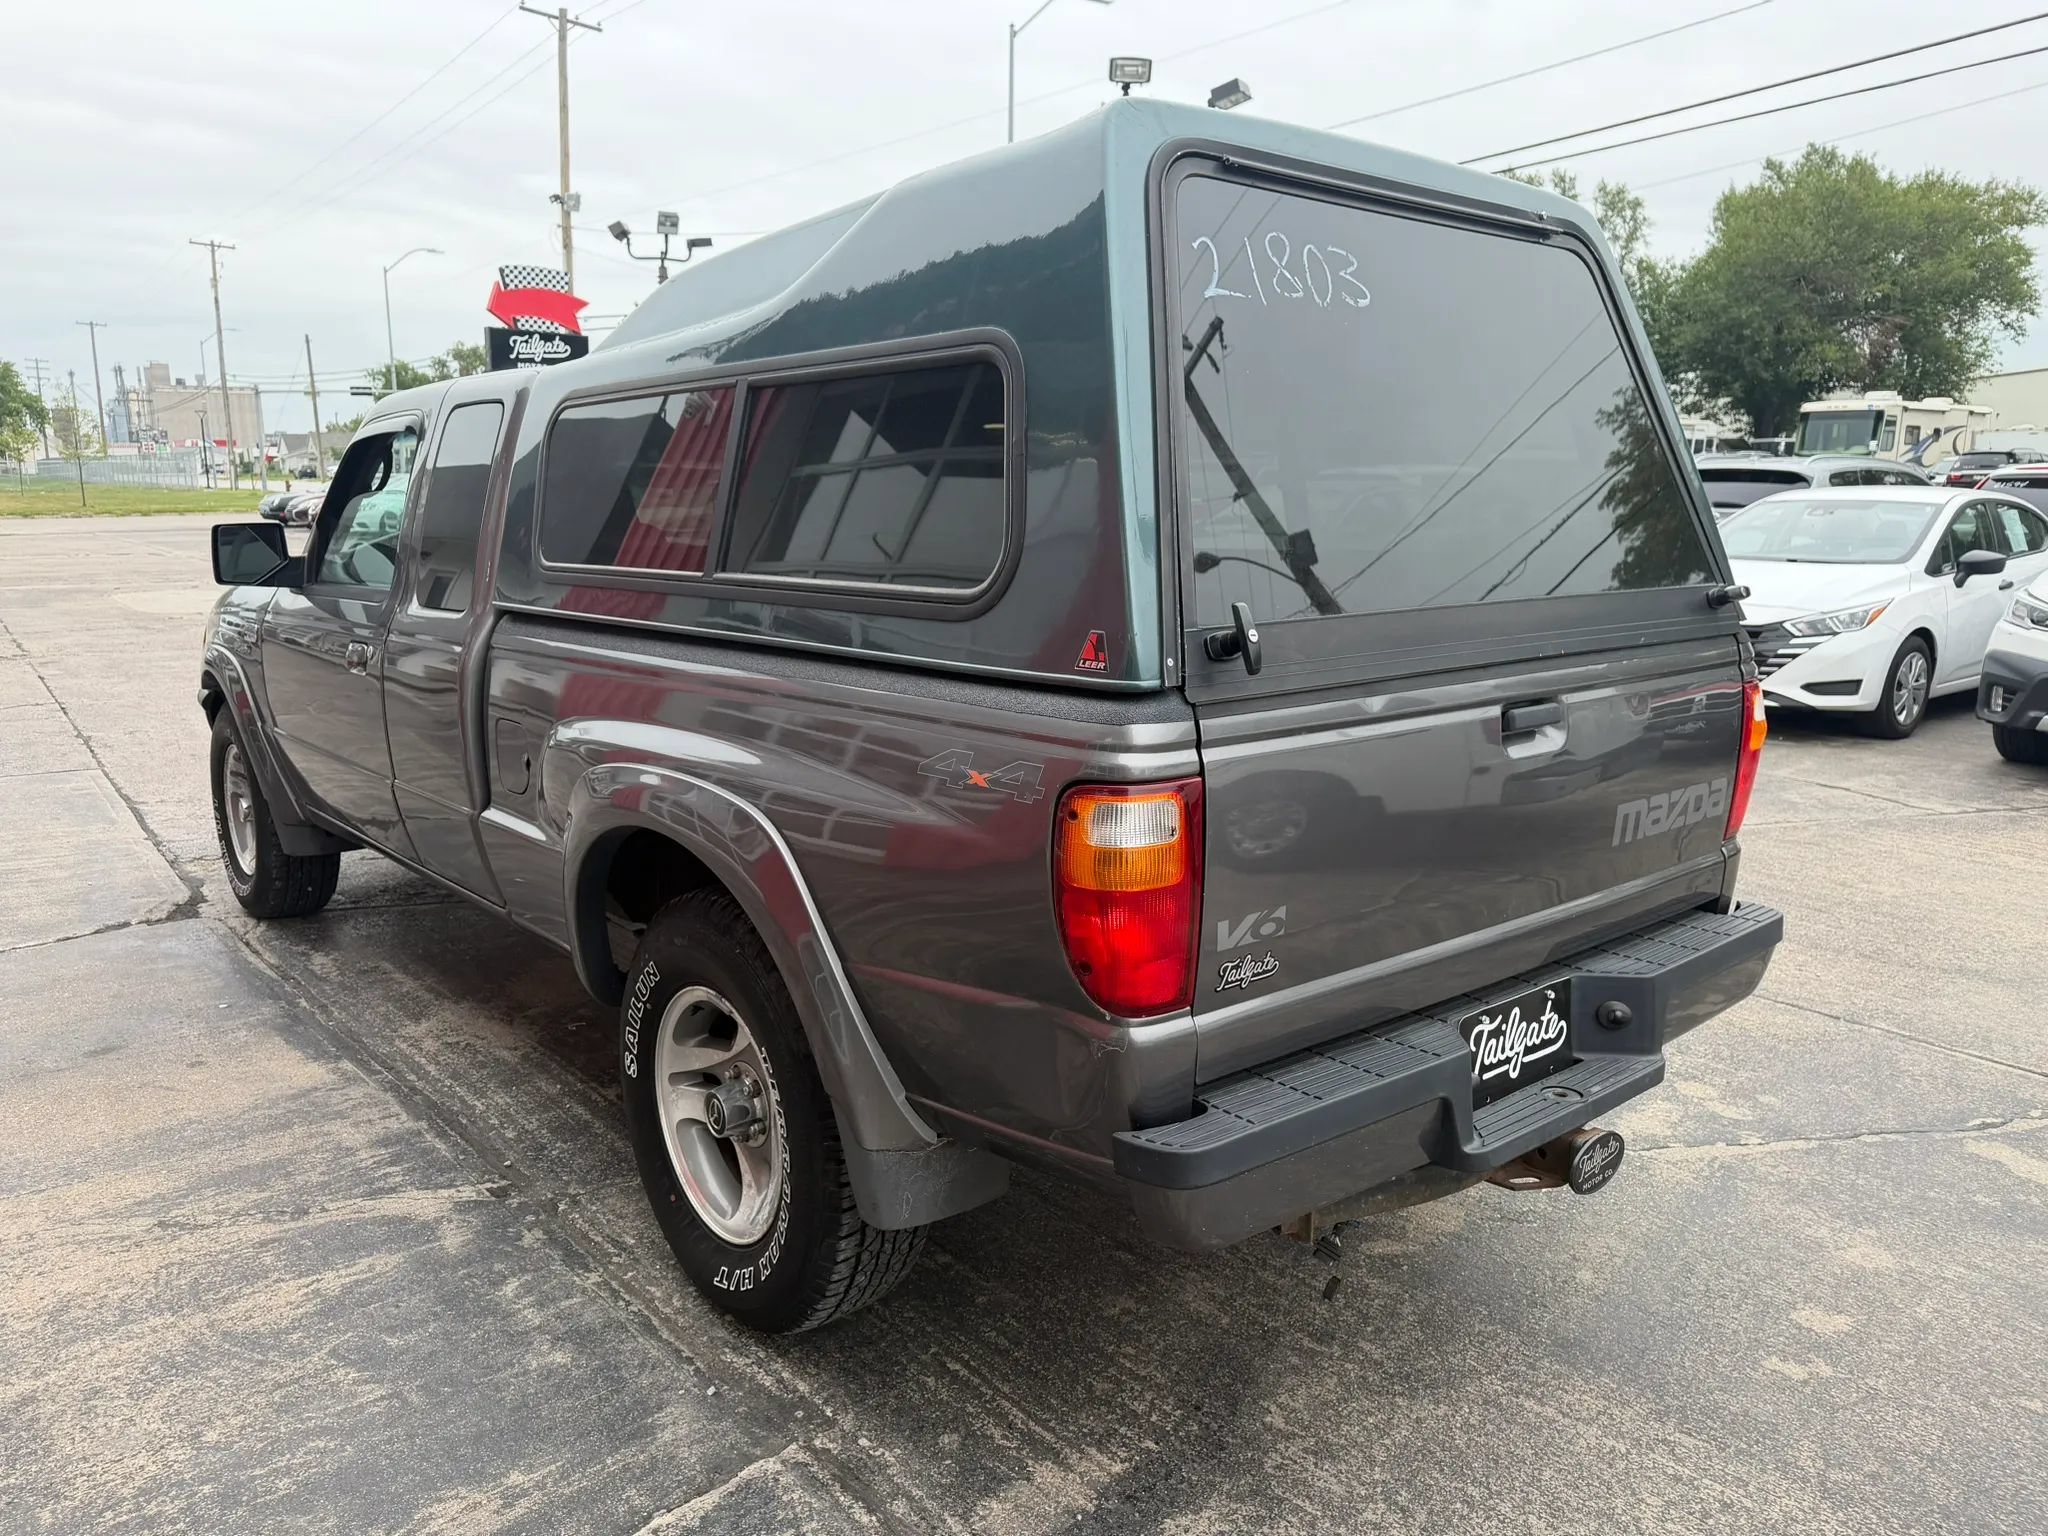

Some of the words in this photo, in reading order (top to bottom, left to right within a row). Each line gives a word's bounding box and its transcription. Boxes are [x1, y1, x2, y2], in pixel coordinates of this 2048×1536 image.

[1192, 232, 1370, 307] 21803
[509, 333, 571, 362] Tailgate
[1078, 659, 1106, 670] LEER
[917, 748, 1046, 805] 4x4
[1217, 905, 1287, 952] V6
[1215, 951, 1280, 992] Tailgate
[623, 960, 661, 1079] SAILUN
[1469, 999, 1568, 1081] Tailgate
[1578, 1135, 1620, 1183] Tailgate
[713, 1265, 755, 1292] H/T
